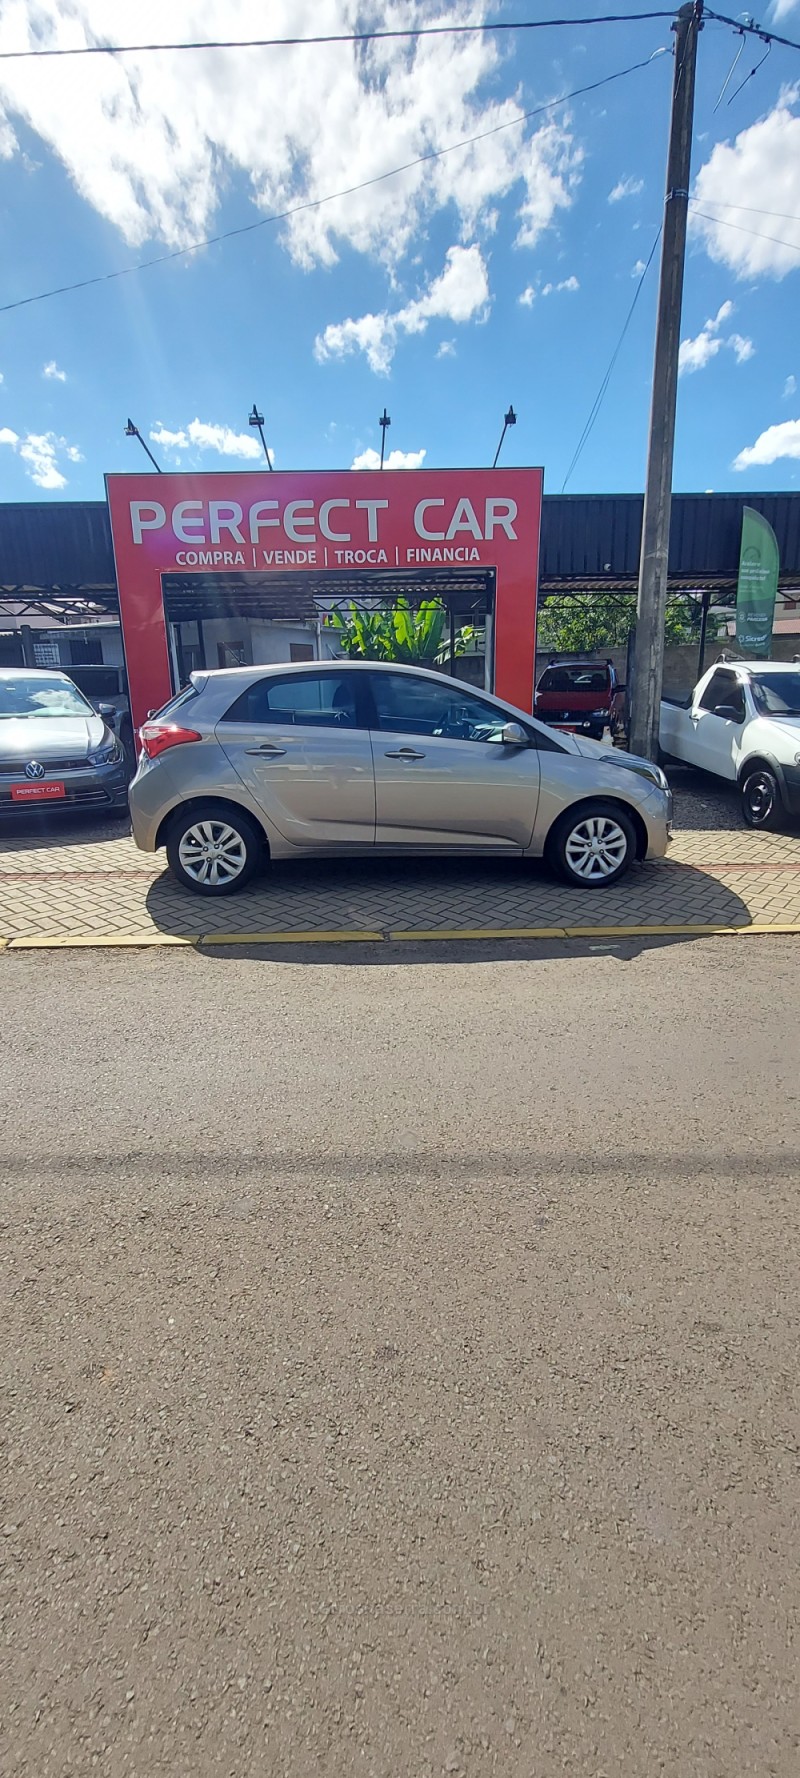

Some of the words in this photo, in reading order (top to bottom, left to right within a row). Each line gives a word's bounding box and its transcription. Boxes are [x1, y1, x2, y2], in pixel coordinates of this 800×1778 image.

[129, 499, 389, 545] PERFECT
[413, 497, 518, 541] CAR
[175, 550, 245, 566] COMPRA
[263, 549, 317, 564] VENDE
[334, 549, 388, 564] TROCA
[406, 547, 480, 562] FINANCIA
[16, 787, 46, 795] PERFECT
